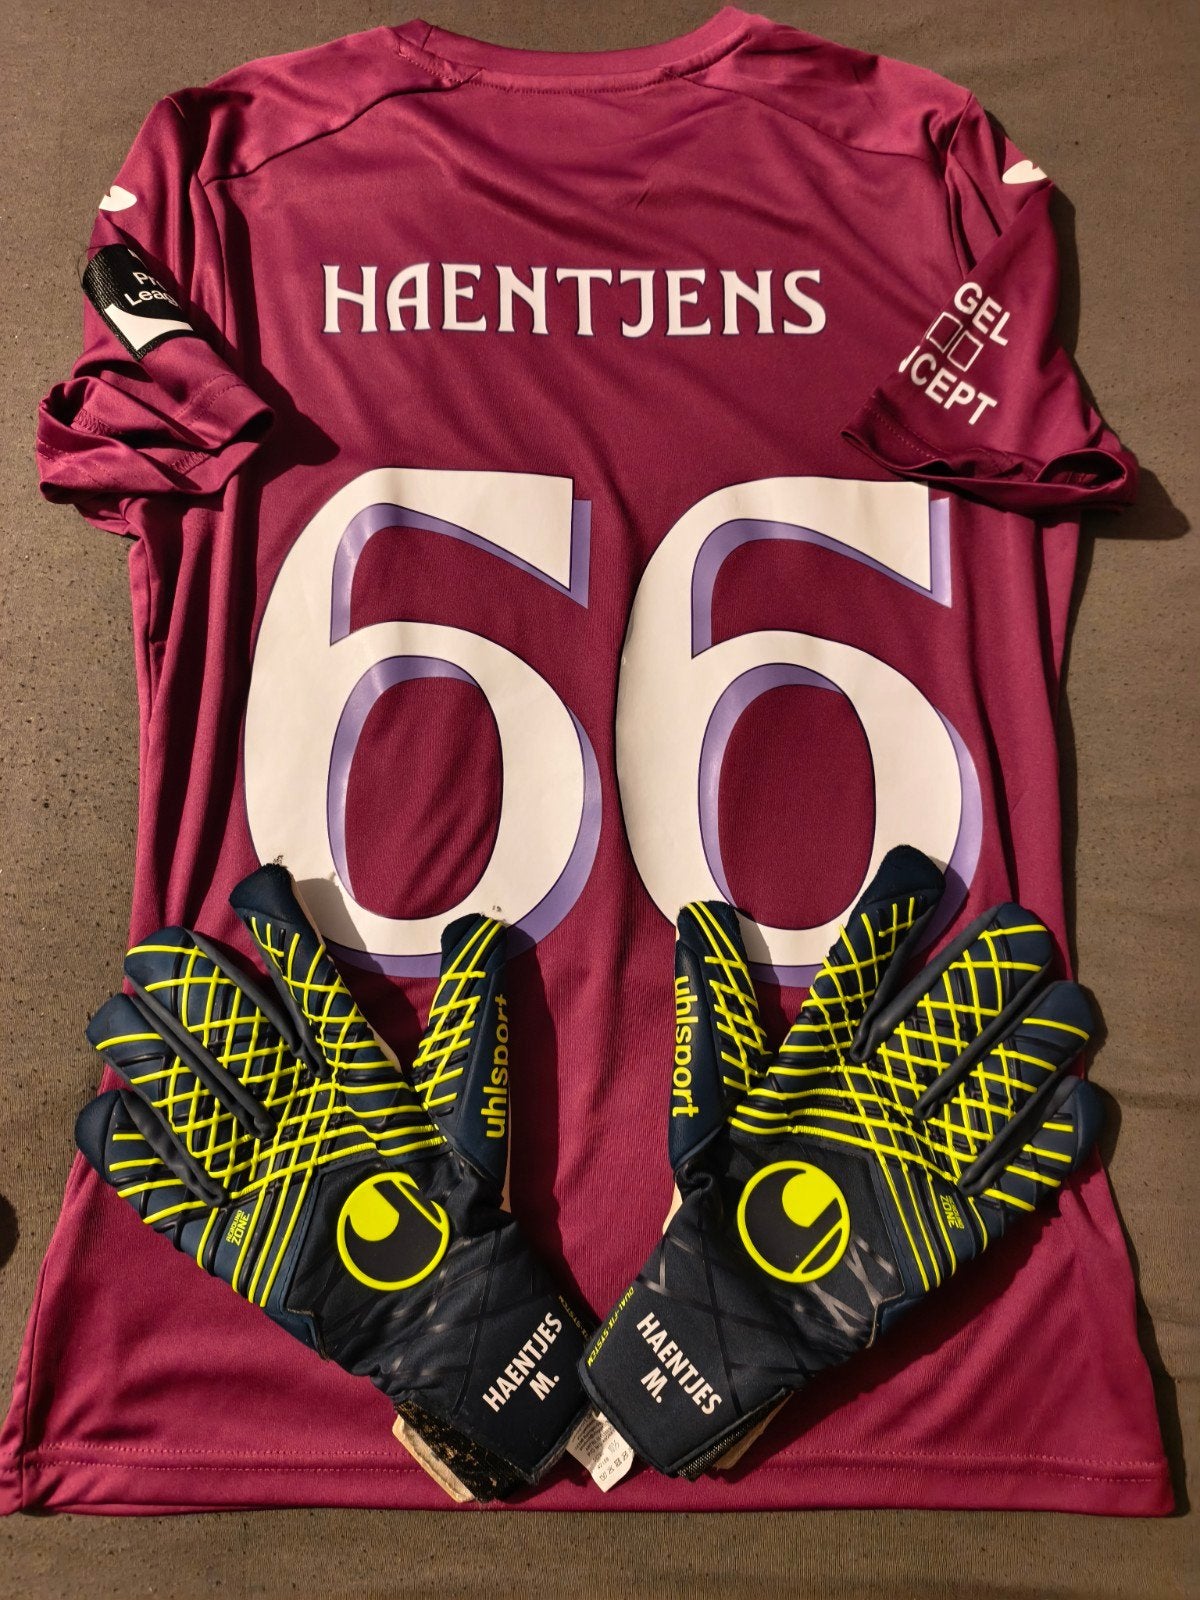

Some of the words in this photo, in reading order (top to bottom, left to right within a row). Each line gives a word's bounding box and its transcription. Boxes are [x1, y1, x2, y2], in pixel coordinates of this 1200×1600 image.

[123, 289, 182, 310] Leag
[132, 271, 168, 292] Pr
[324, 262, 827, 337] HAENTJENS
[243, 467, 983, 988] 66
[480, 993, 510, 1140] uhlsport
[671, 975, 700, 1119] uhlsport
[232, 1213, 250, 1246] ZONE
[482, 1312, 563, 1413] HAENTJES
[528, 1370, 561, 1402] M.
[636, 1311, 723, 1416] HAENTJES
[640, 1366, 669, 1404] M.
